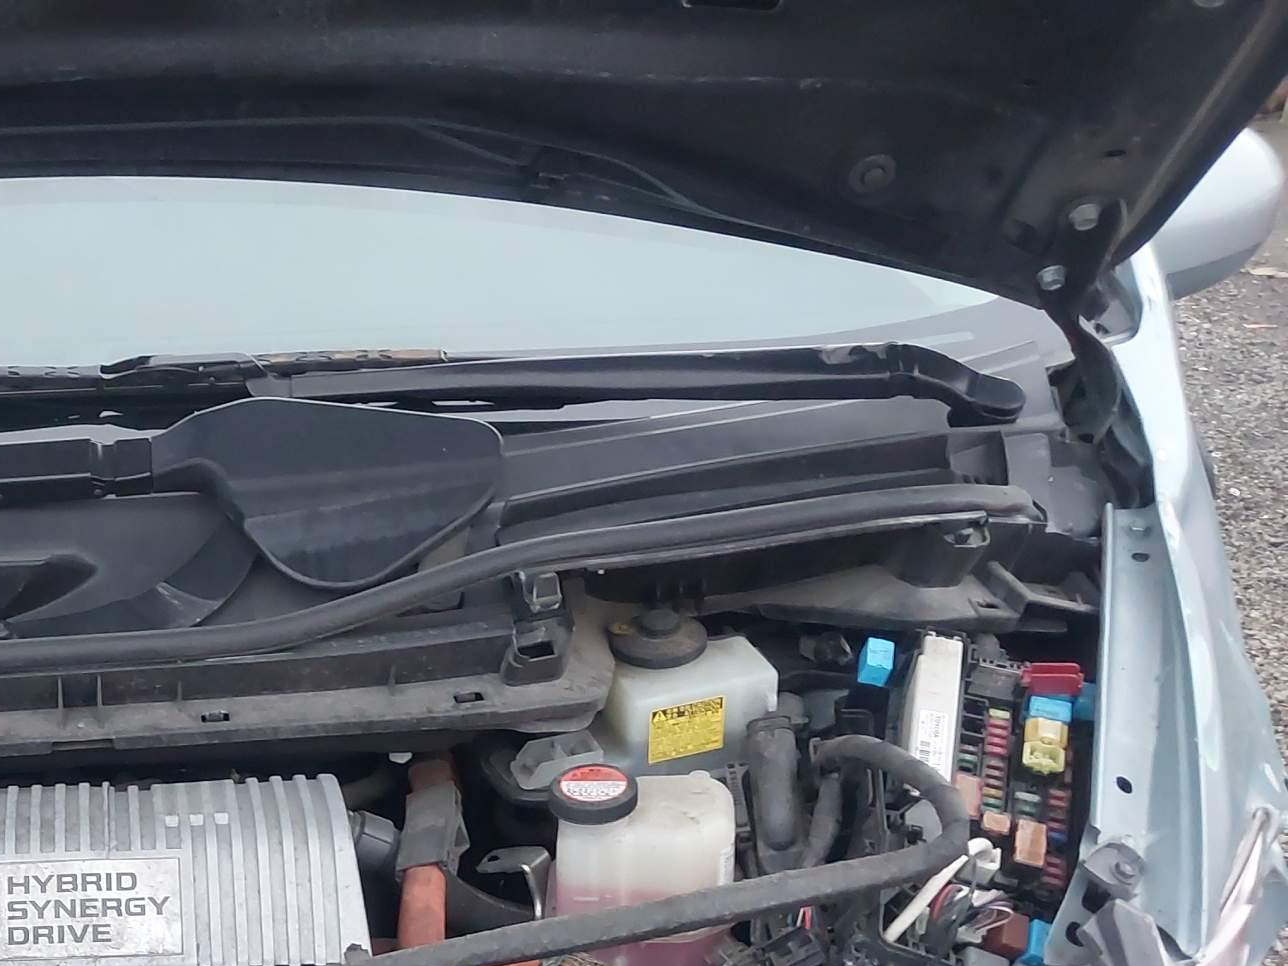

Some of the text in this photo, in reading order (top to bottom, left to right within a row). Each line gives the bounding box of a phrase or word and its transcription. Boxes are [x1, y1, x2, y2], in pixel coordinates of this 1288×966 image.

[7, 872, 137, 895] HYBRID
[7, 896, 170, 920] SYNERGY
[7, 924, 113, 946] DRIVE
